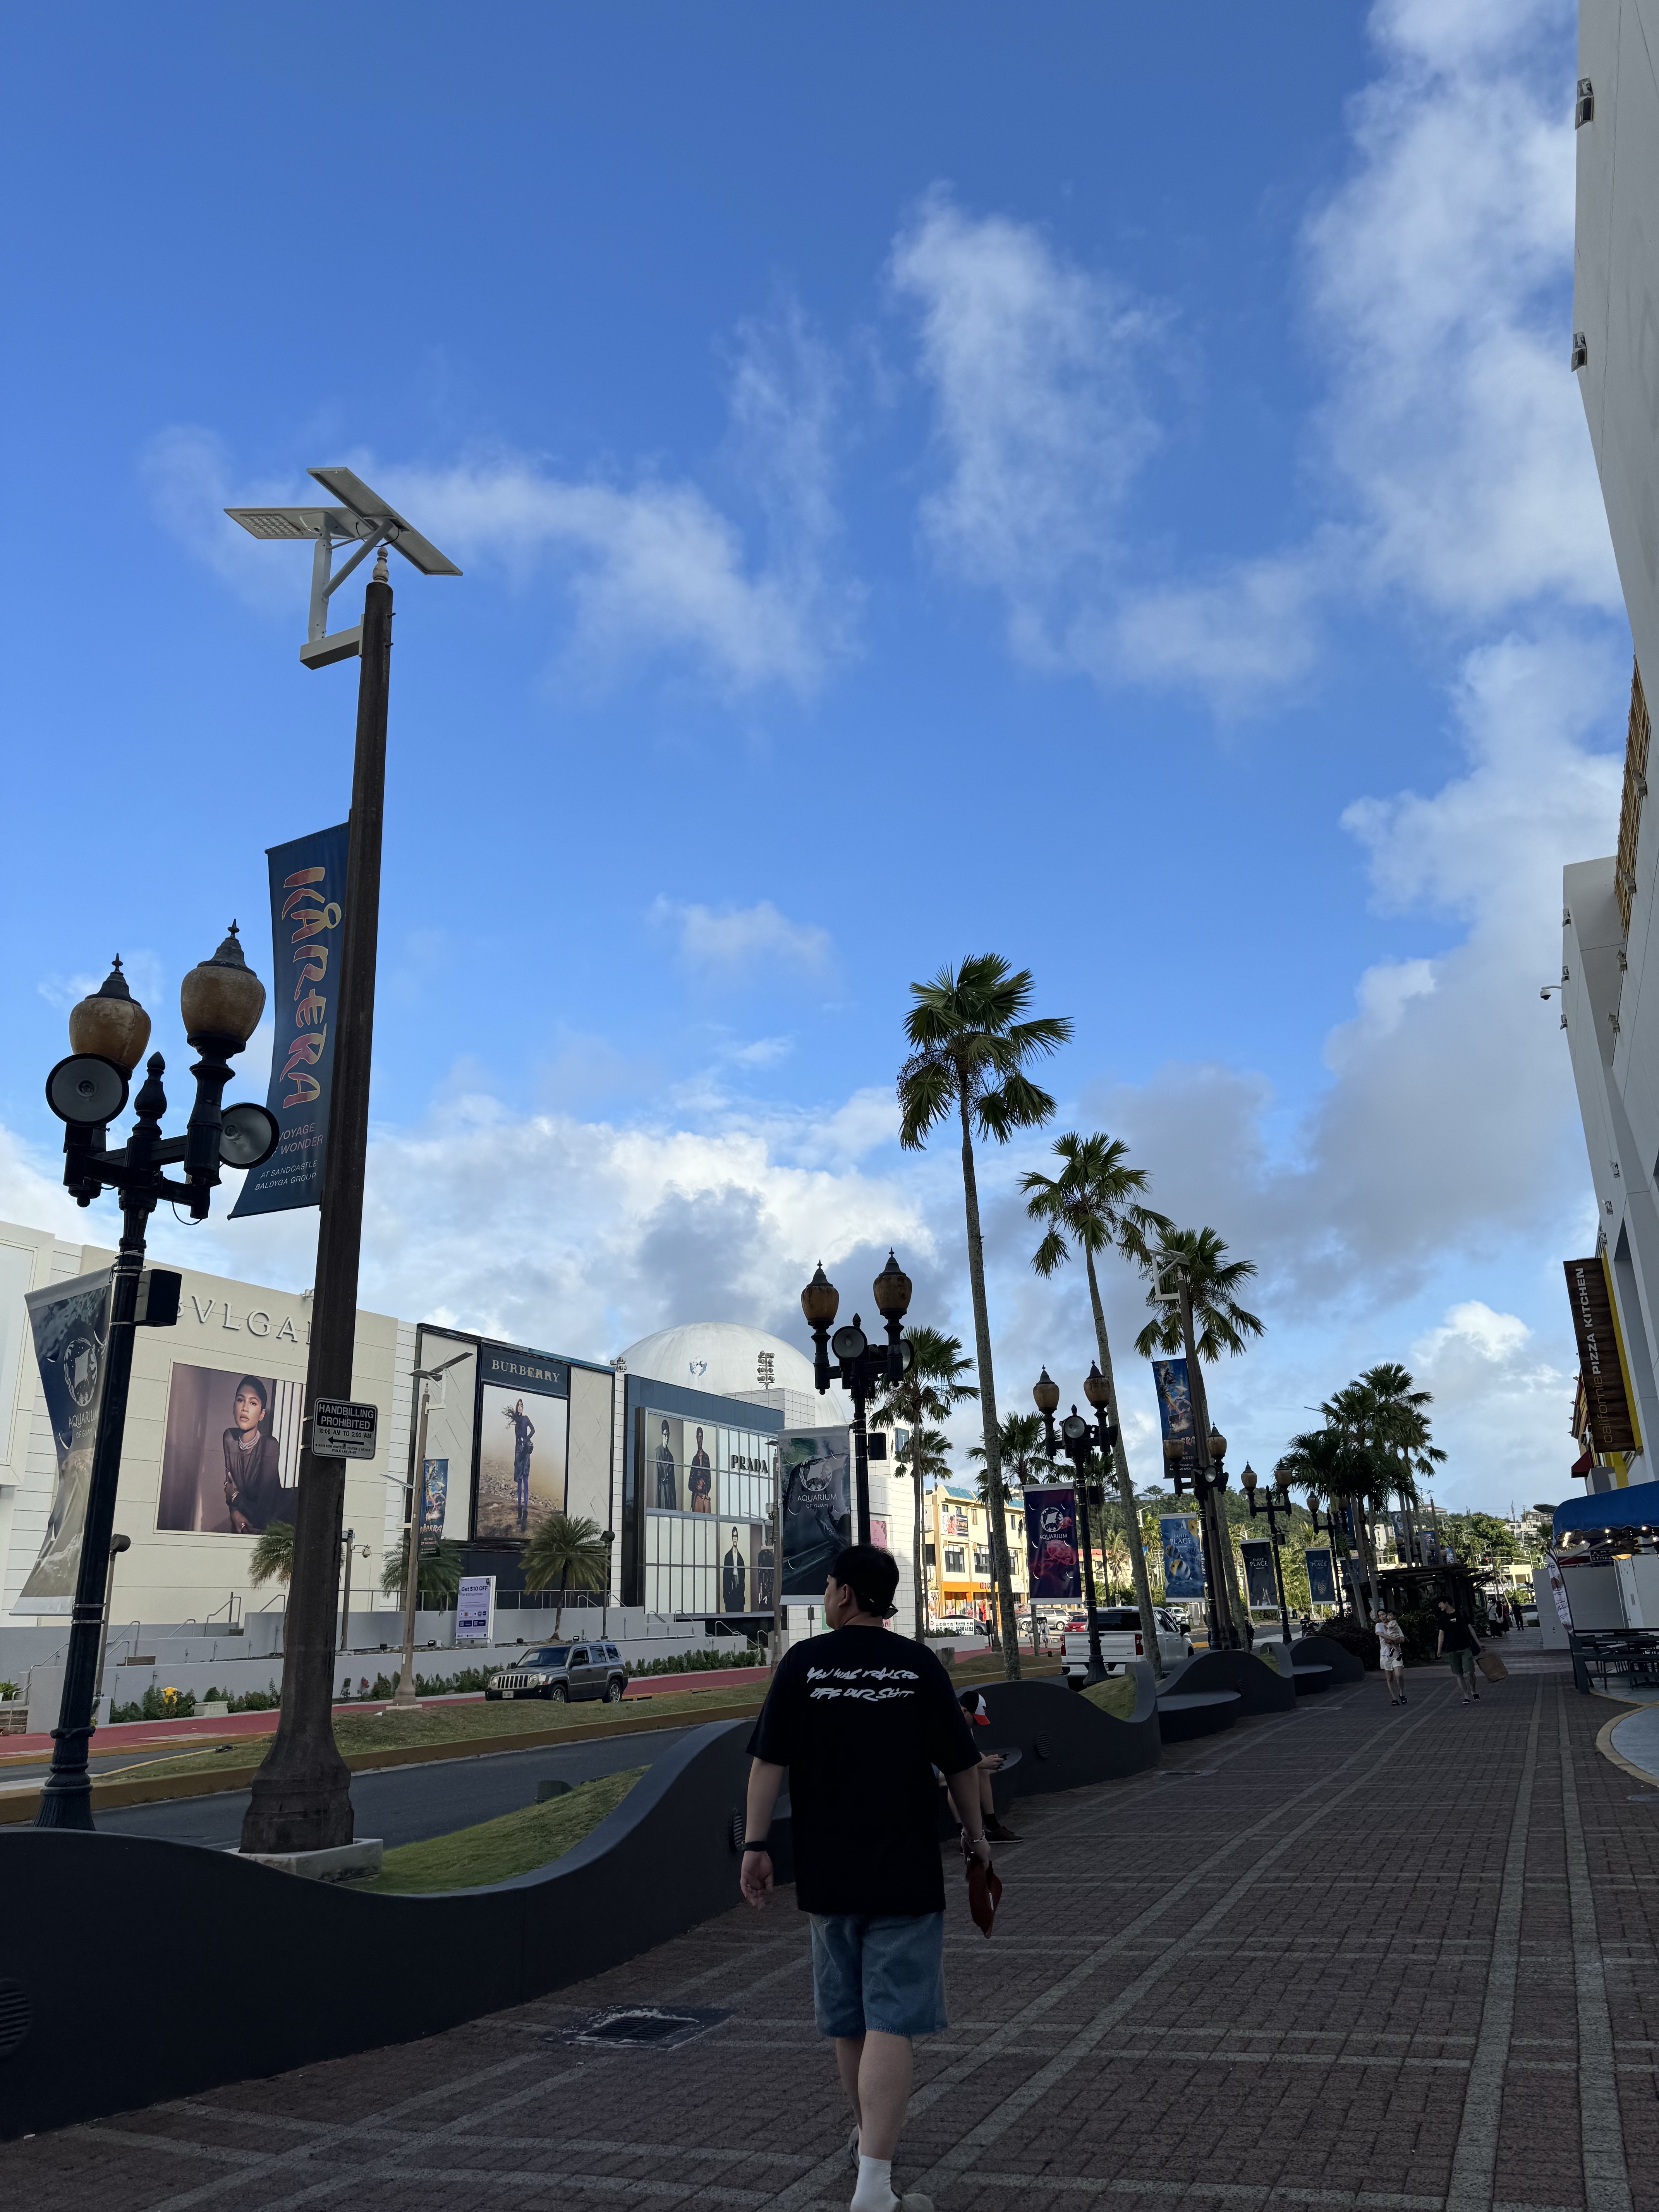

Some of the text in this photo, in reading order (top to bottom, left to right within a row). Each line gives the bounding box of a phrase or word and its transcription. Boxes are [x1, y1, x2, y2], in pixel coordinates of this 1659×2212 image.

[281, 1135, 323, 1154] WONDER
[271, 1160, 317, 1176] SANDCASTLE
[255, 1173, 316, 1190] BALDYGA GROUP
[1575, 1268, 1613, 1443] california PIZZA KITCHEN
[491, 1359, 560, 1382] BURBERRY
[319, 1404, 374, 1419] HANDBILLING
[321, 1416, 370, 1429] PROHIBITED
[732, 1455, 768, 1474] PRADA
[797, 1494, 837, 1503] AQUARIUM
[833, 1668, 862, 1680] WAS
[810, 1688, 842, 1699] OFF
[843, 1688, 878, 1701] OUR
